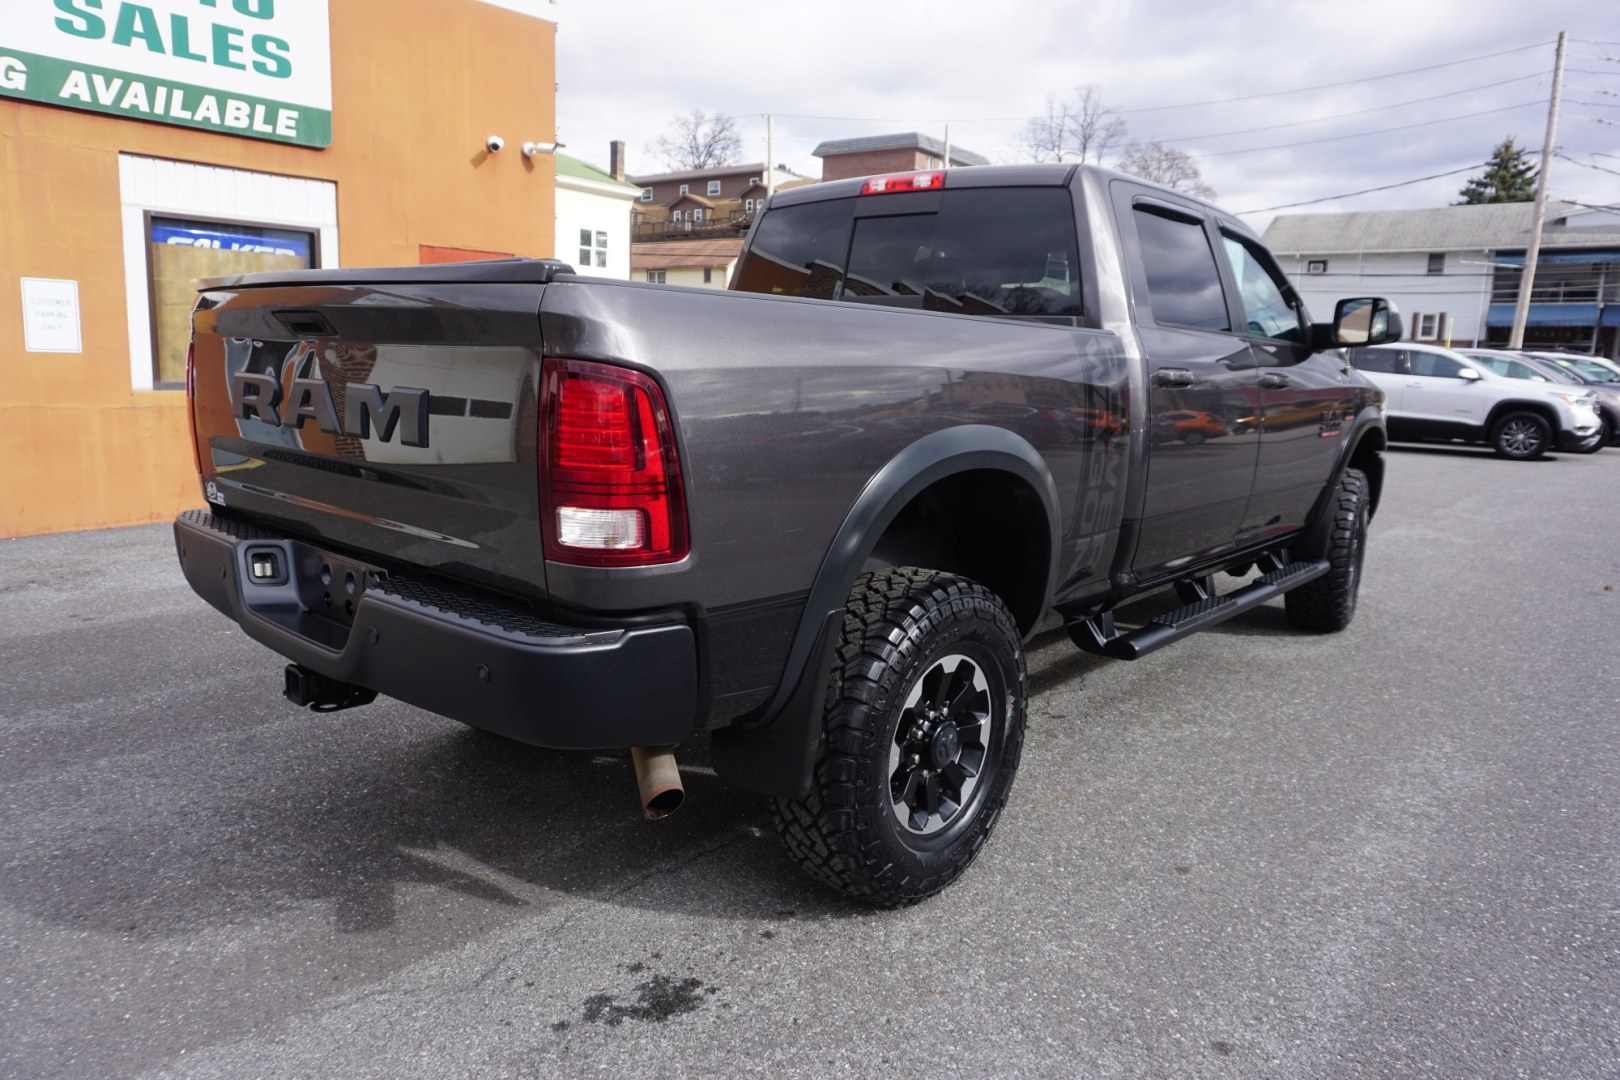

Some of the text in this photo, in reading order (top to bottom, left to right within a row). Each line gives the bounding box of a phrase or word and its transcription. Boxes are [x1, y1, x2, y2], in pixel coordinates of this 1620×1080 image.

[54, 0, 292, 79] SALES
[59, 70, 299, 137] AVAILABLE
[35, 310, 68, 319] PARKING
[42, 323, 62, 331] ONLY
[232, 371, 430, 449] RAM
